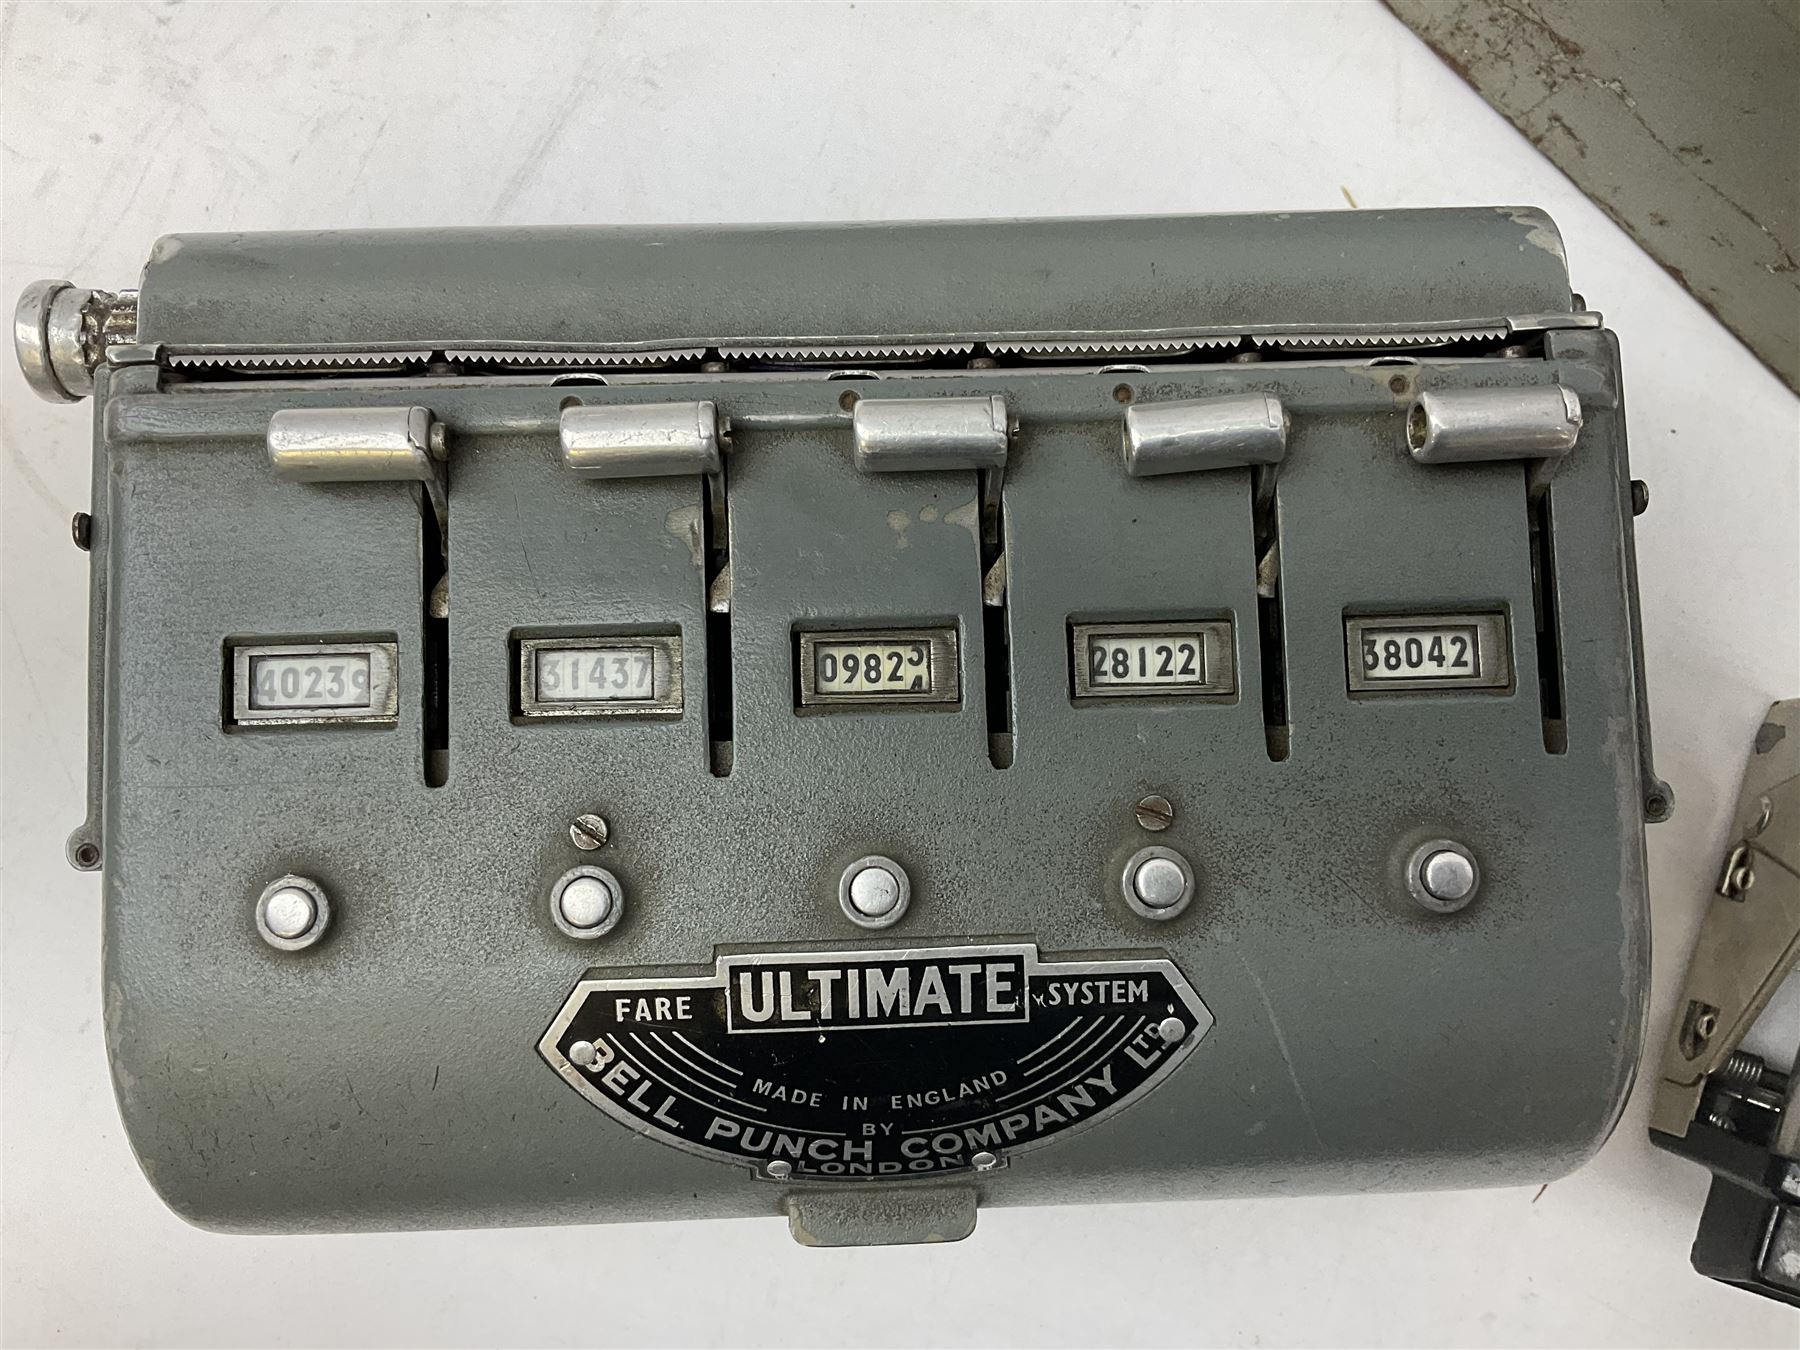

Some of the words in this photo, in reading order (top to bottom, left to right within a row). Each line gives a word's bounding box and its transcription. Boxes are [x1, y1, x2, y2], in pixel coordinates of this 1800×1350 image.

[1093, 643, 1196, 679] 28122
[1362, 635, 1469, 671] 38042
[257, 665, 368, 702] 40239
[541, 656, 651, 692] 31437
[615, 995, 693, 1022] FARE
[738, 962, 1016, 1023] ULTIMATE
[1048, 979, 1149, 1006] SYSTEM
[585, 1037, 680, 1129] BELL
[704, 1115, 873, 1162] PUNCH
[900, 1063, 1119, 1159] COMPANY
[752, 1078, 823, 1108] MADE
[842, 1095, 868, 1111] IN
[891, 1070, 1008, 1110] ENGLAND
[862, 1122, 894, 1137] BY
[796, 1153, 966, 1174] LONDON
